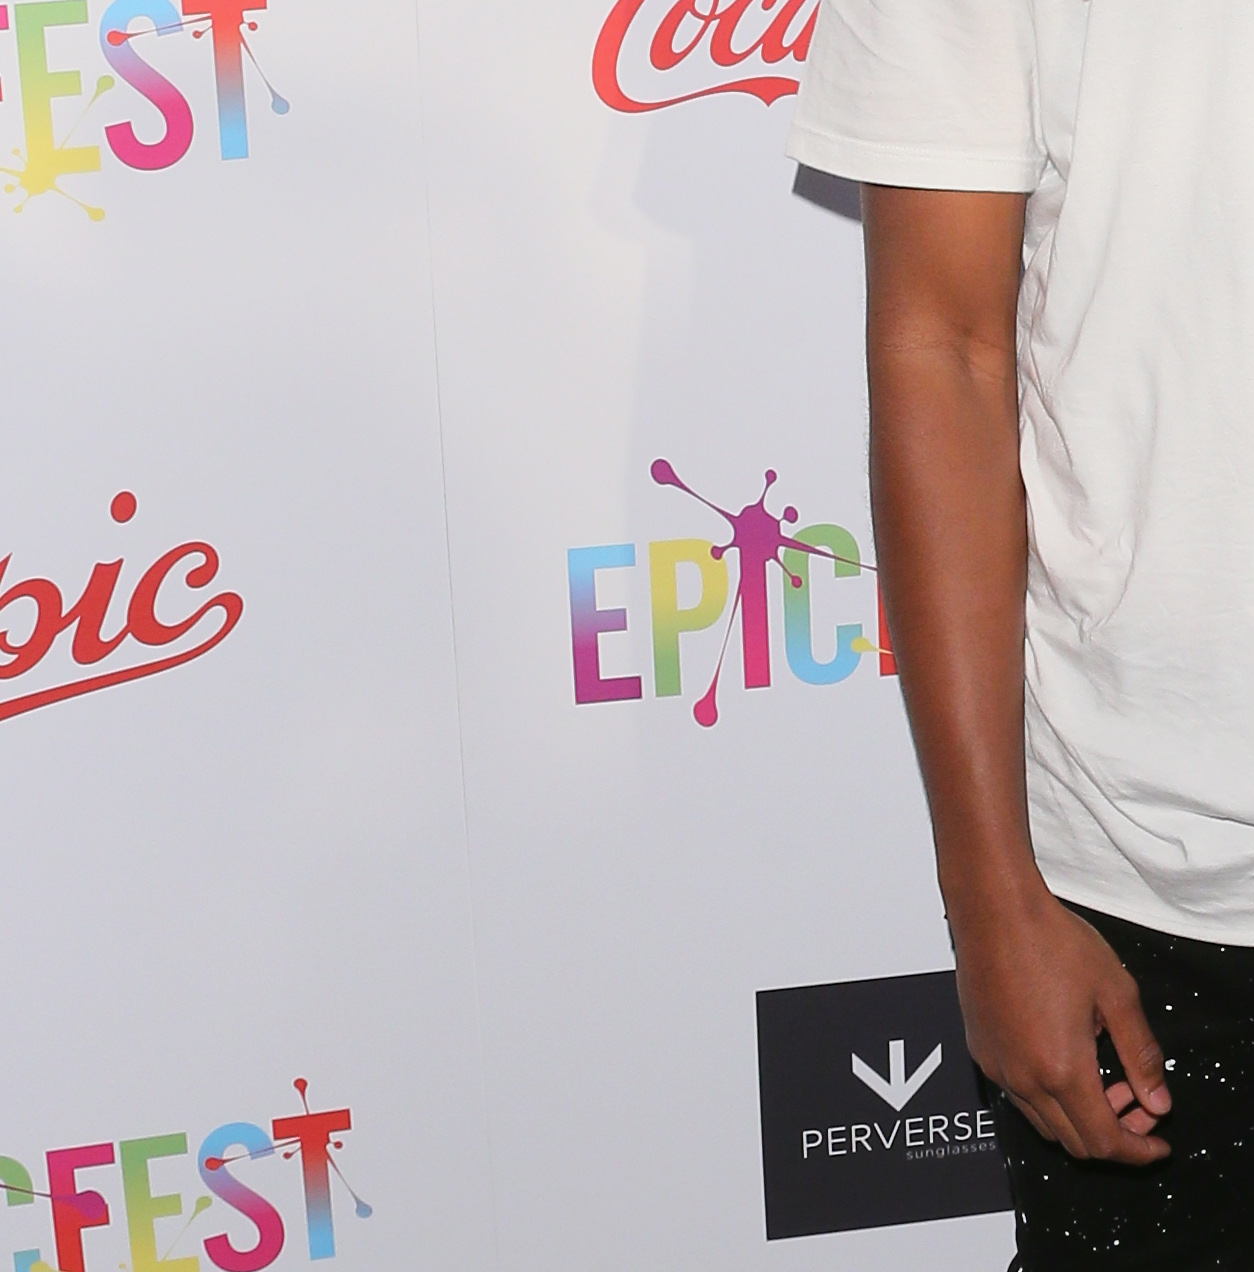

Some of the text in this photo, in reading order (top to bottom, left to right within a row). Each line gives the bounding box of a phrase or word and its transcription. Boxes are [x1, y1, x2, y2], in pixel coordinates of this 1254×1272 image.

[567, 523, 899, 705] EPIC
[803, 1110, 996, 1159] PERVERSE
[906, 1141, 996, 1160] sunglasses
